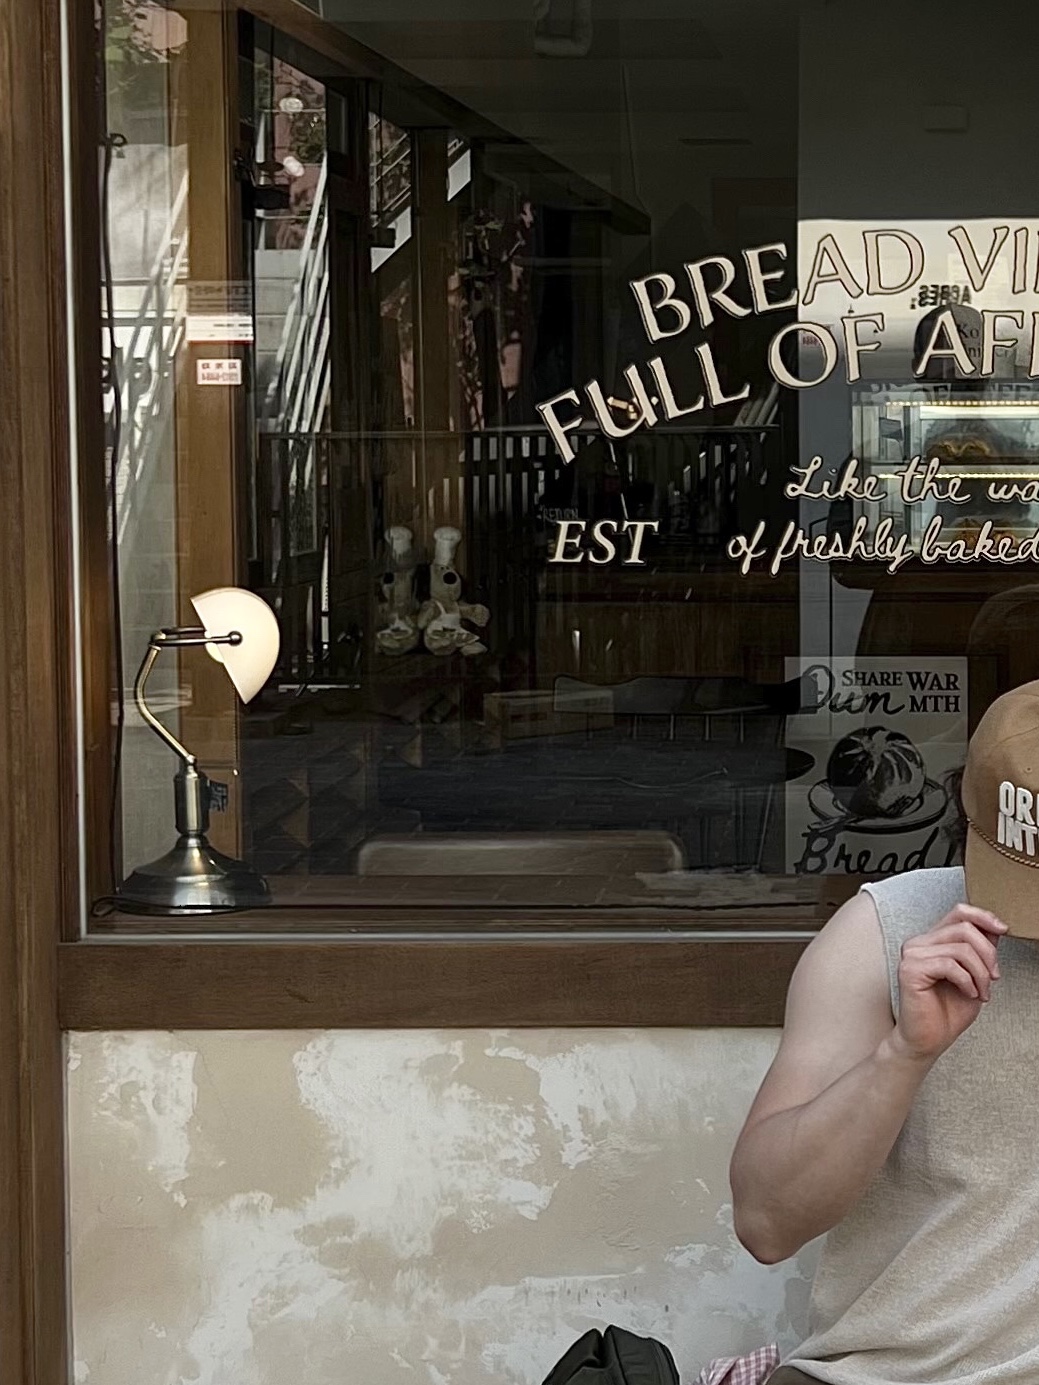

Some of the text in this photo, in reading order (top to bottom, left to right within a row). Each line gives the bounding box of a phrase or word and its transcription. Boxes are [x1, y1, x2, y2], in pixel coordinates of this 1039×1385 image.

[629, 227, 925, 343] BREAD
[535, 342, 751, 466] FULL
[767, 312, 885, 390] OF
[785, 456, 887, 504] Like
[895, 458, 973, 504] the
[548, 519, 660, 566] EST
[727, 520, 767, 576] of
[770, 518, 914, 577] freshly
[841, 670, 960, 691] SHARE WAR
[909, 695, 960, 713] MTH
